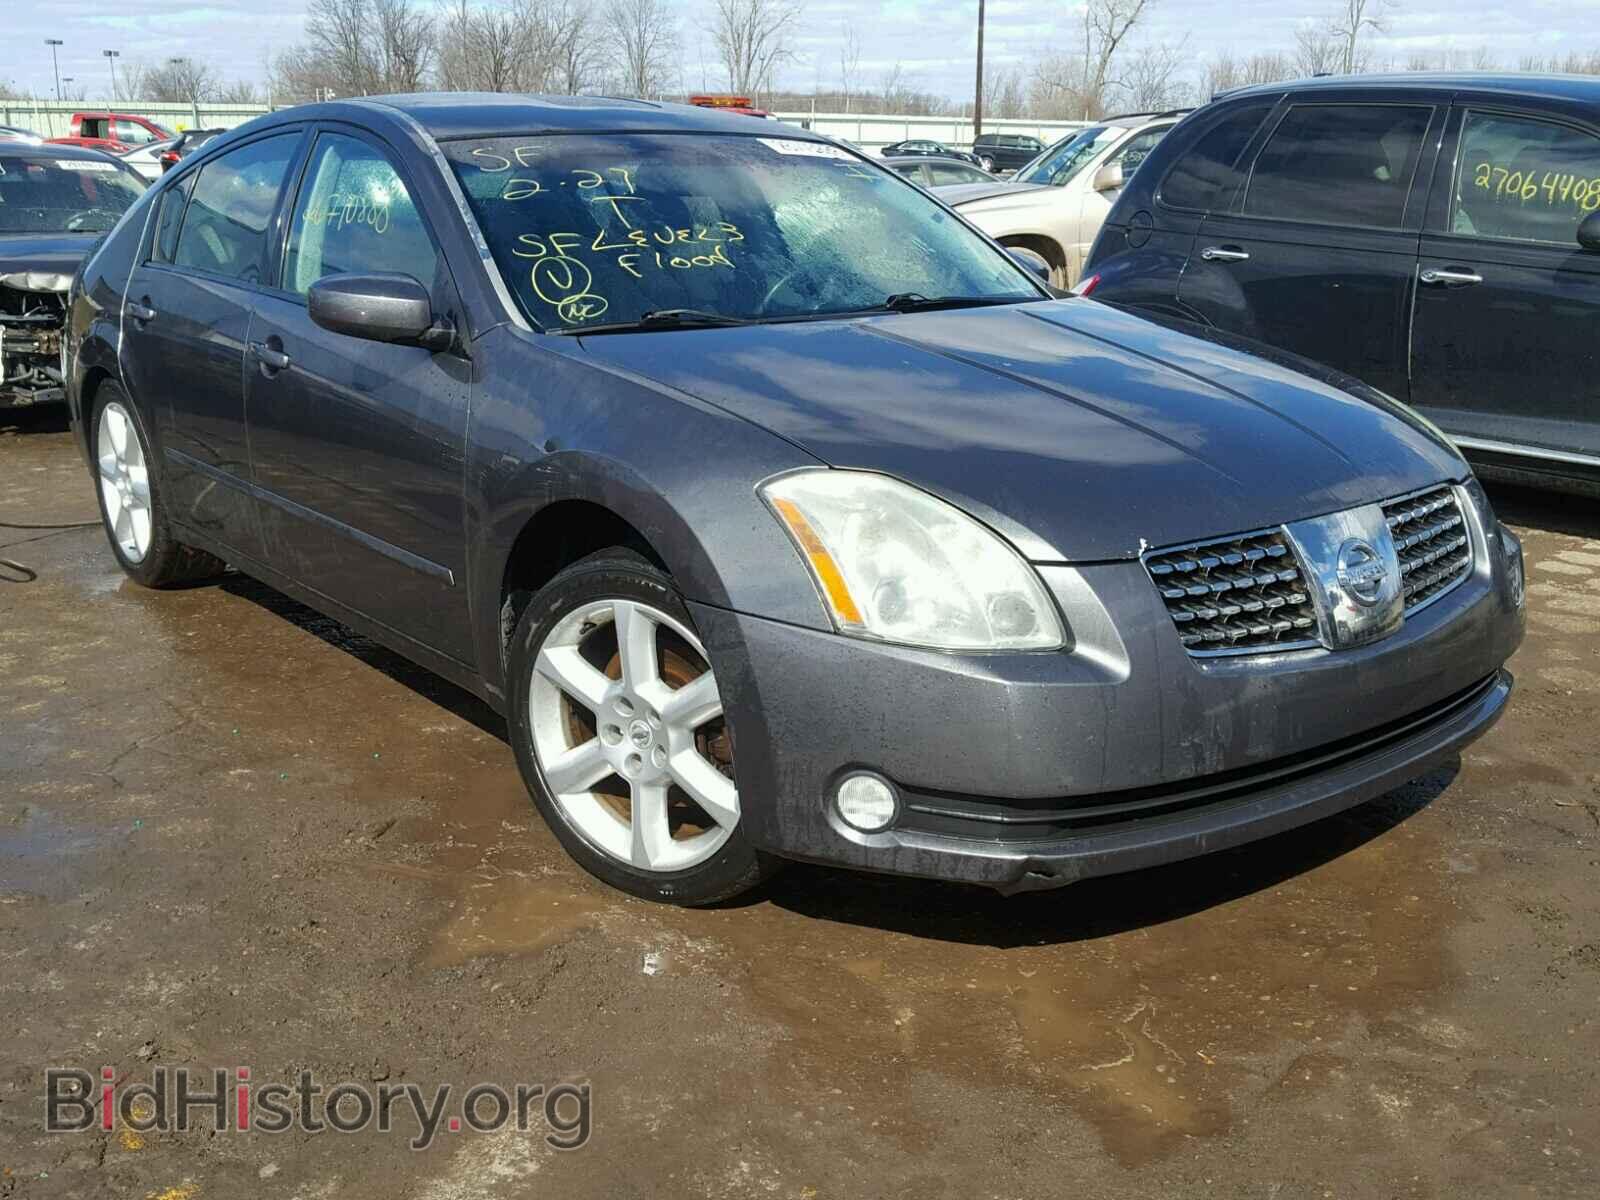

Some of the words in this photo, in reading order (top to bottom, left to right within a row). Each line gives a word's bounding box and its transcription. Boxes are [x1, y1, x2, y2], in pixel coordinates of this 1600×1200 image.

[472, 145, 545, 172] SF
[1475, 163, 1600, 210] 27064408
[512, 232, 582, 258] SF
